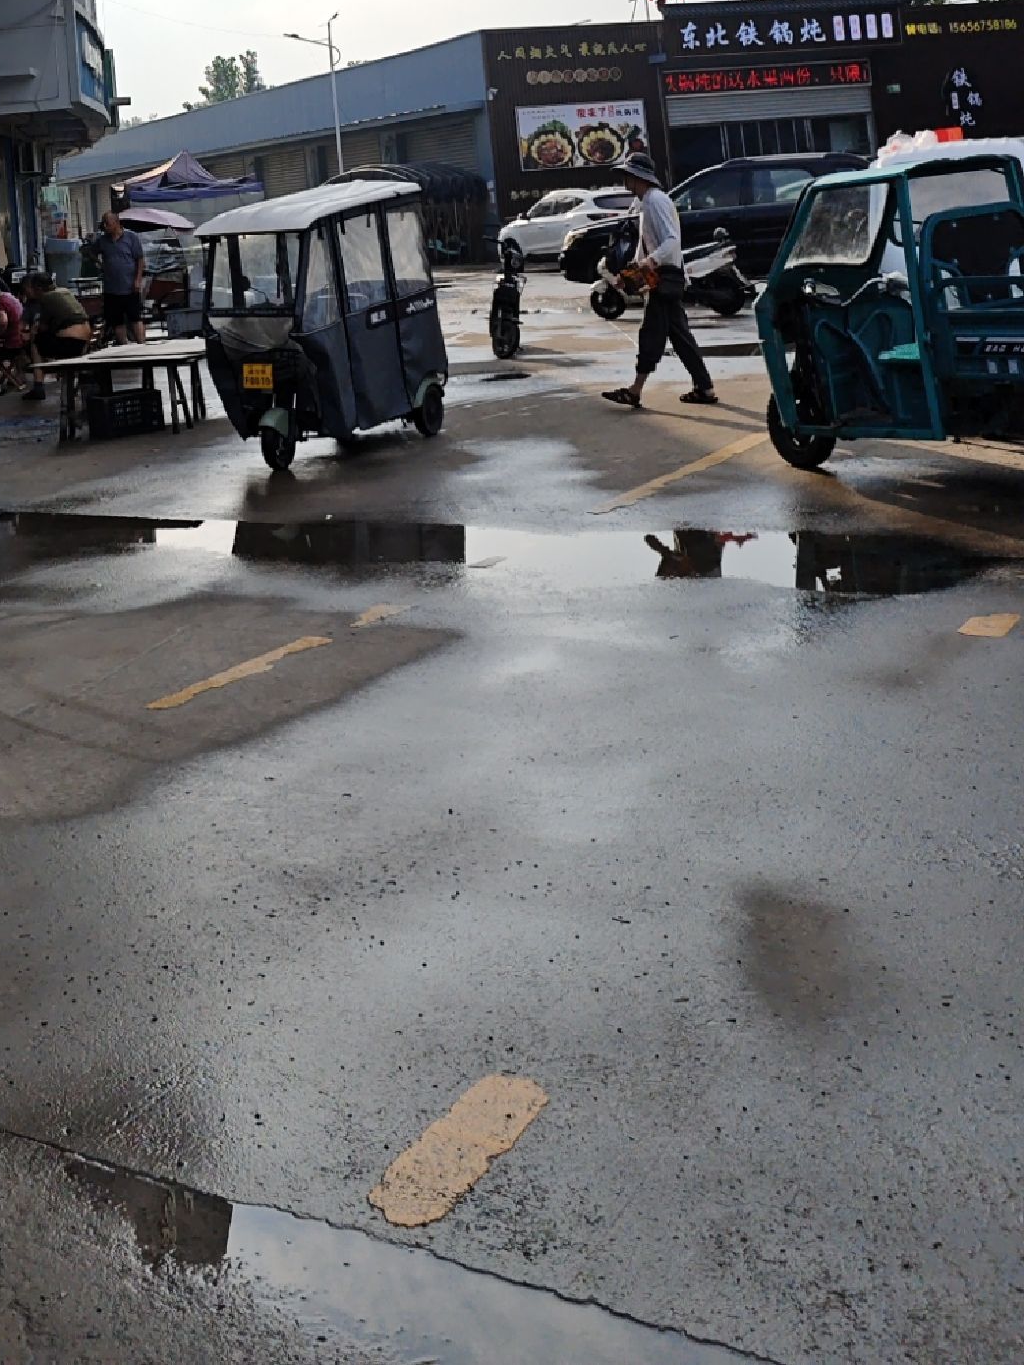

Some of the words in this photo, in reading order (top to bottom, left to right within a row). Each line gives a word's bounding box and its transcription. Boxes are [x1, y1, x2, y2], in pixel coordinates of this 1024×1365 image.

[680, 18, 826, 50] 东北铁锅炖
